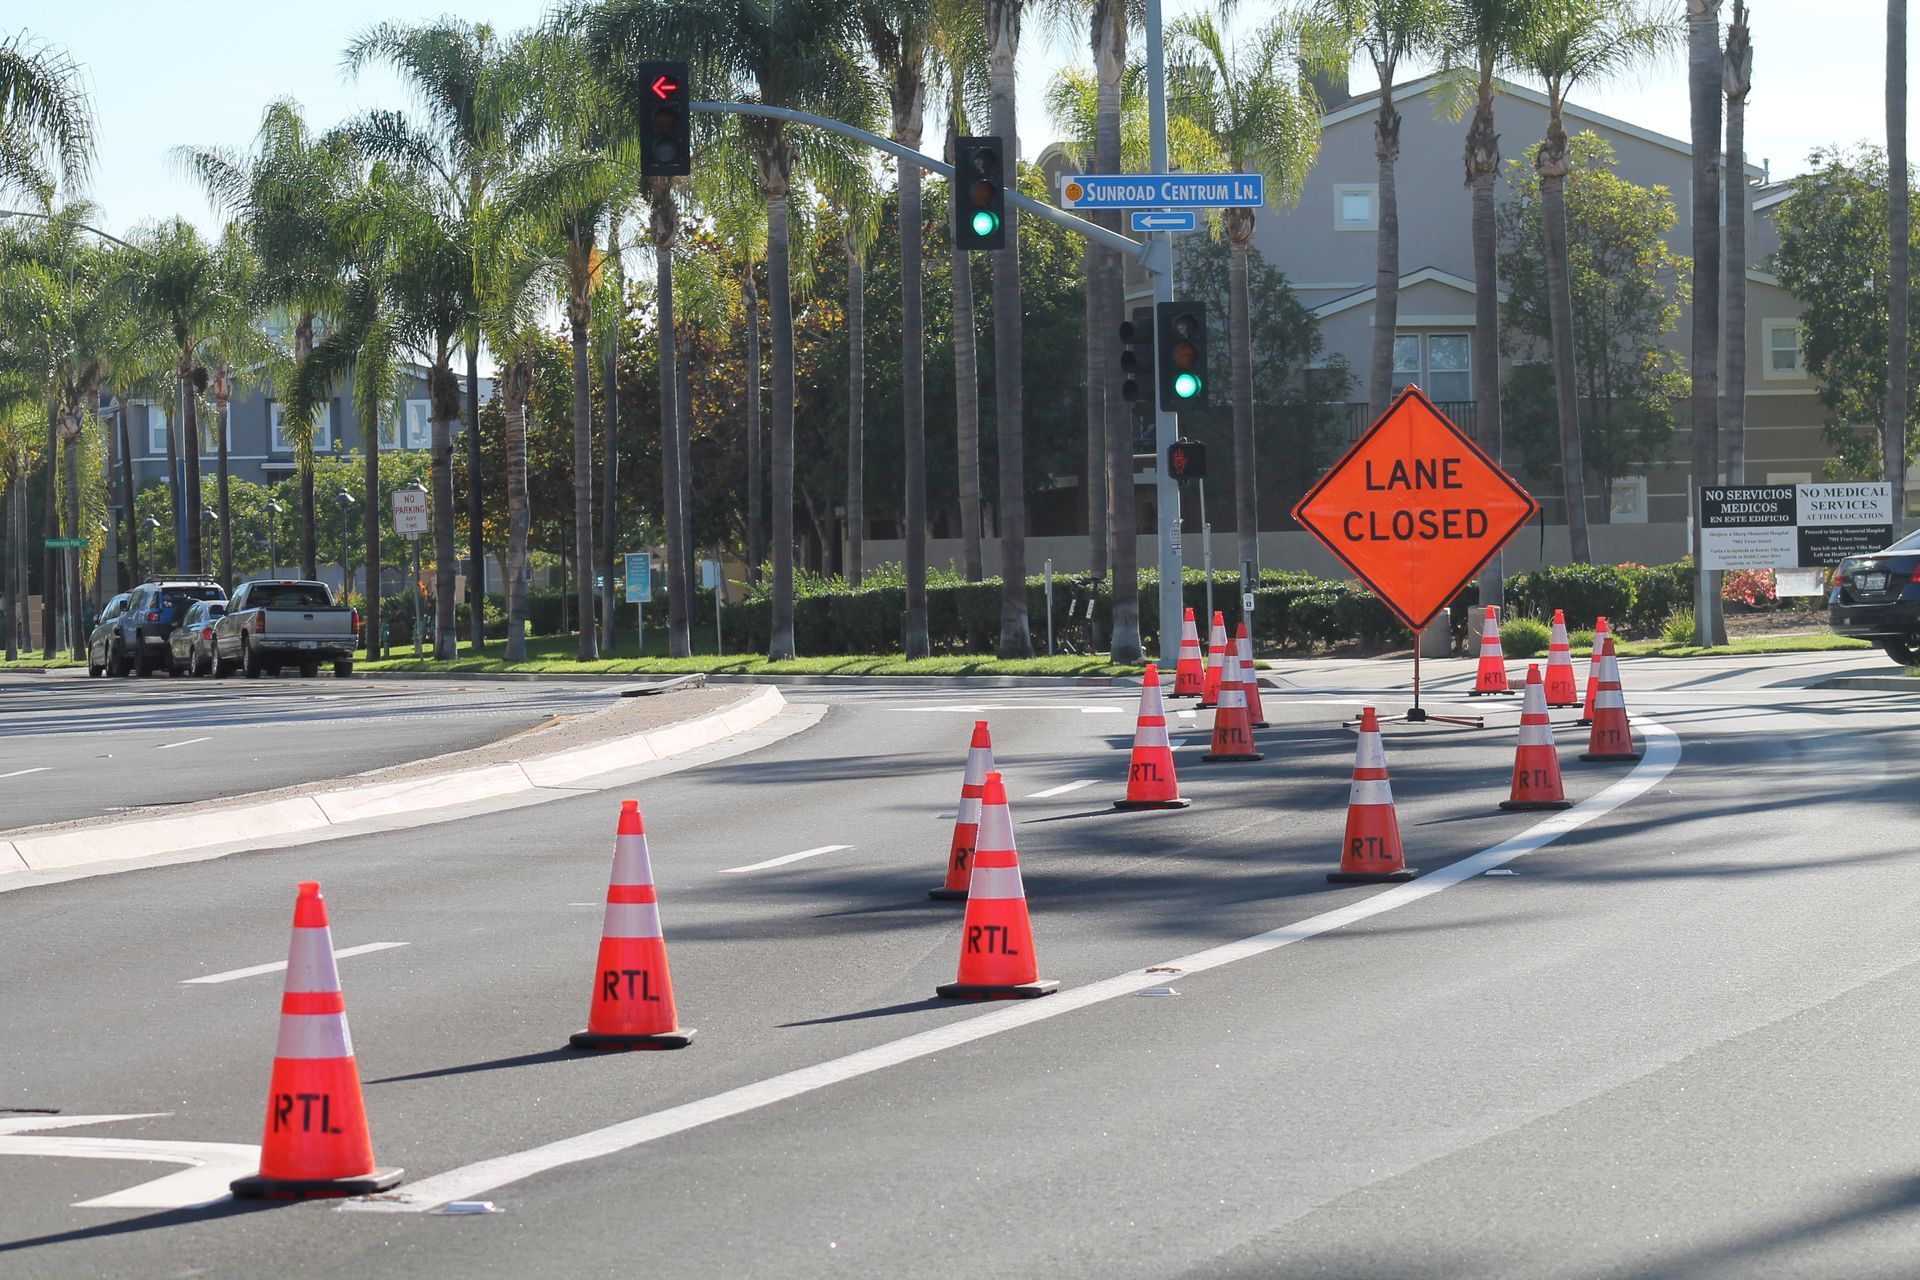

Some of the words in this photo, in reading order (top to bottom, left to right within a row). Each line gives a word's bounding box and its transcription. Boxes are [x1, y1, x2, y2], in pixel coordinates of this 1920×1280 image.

[1086, 182, 1155, 201] SUNROAD
[1160, 182, 1228, 200] CENTRUM
[1366, 458, 1462, 491] LANE
[404, 495, 414, 503] NO
[1706, 491, 1723, 500] NO
[1726, 489, 1792, 500] SERVICIOS
[1800, 488, 1820, 498] NO
[1824, 487, 1888, 497] MEDICAL
[396, 505, 424, 514] PARKING
[1721, 503, 1778, 513] MEDICOS
[1810, 500, 1877, 510] SERVICES
[1344, 509, 1488, 541] CLOSED
[1179, 673, 1199, 686] RTL
[1484, 672, 1504, 684] RTL
[1552, 681, 1573, 694] RTL
[1219, 728, 1247, 744] RTL
[1597, 730, 1624, 745] RTL
[1131, 763, 1163, 782] RTL
[1520, 770, 1553, 788] RTL
[1351, 837, 1392, 860] RTL
[967, 925, 1018, 956] RTL
[602, 970, 659, 1002] RTL
[273, 1094, 344, 1134] RTL
